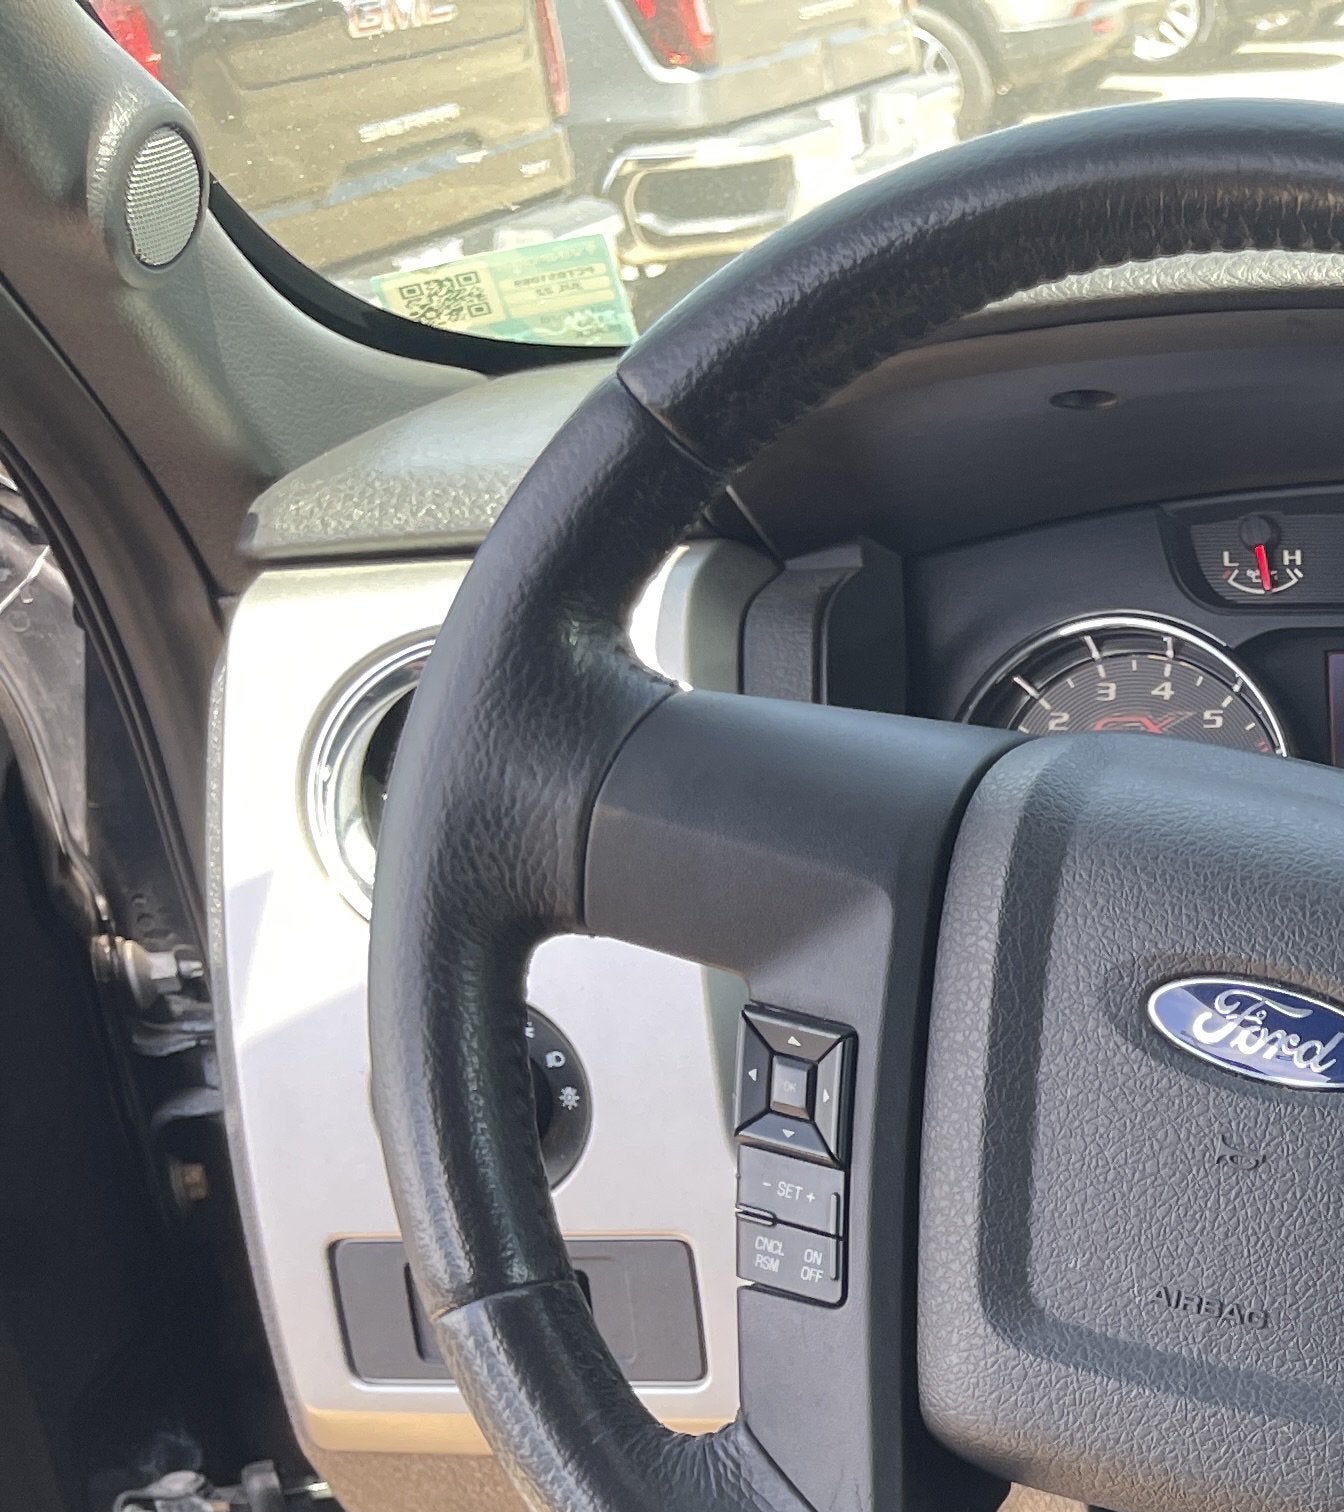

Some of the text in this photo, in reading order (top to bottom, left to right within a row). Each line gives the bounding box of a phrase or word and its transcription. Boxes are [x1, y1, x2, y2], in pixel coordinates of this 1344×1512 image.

[1222, 549, 1240, 567] L
[1283, 548, 1302, 566] H
[1096, 682, 1117, 701] 3
[1151, 681, 1175, 701] 4
[1048, 712, 1070, 731] 2
[1203, 709, 1224, 729] 5
[777, 1180, 803, 1202] SET
[754, 1235, 785, 1258] CNCL
[754, 1253, 780, 1273] RSM
[803, 1249, 823, 1268] ON
[800, 1266, 824, 1284] OFF
